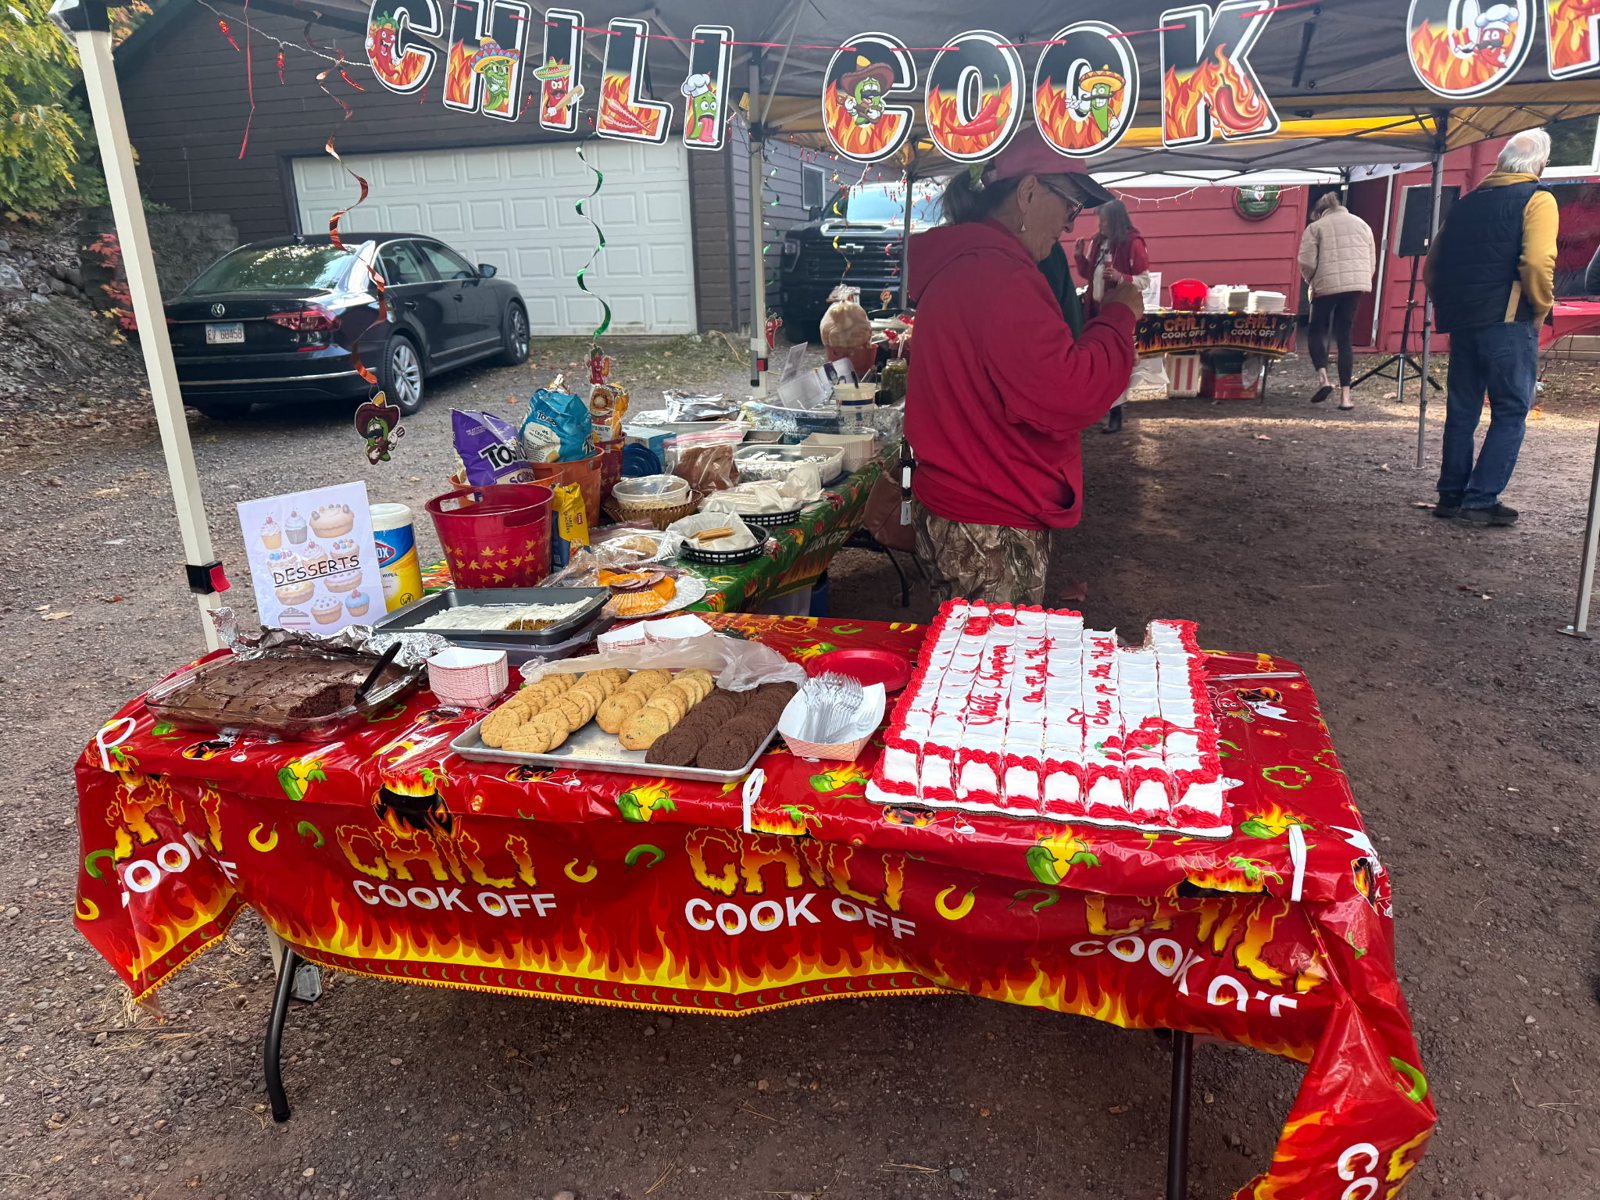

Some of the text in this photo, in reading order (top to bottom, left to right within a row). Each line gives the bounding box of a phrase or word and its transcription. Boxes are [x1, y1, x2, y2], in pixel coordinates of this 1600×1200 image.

[365, 0, 734, 151] CHILI
[823, 0, 1281, 163] COOK
[1161, 330, 1207, 340] COOK OFF
[1163, 316, 1206, 331] CHILI
[1231, 328, 1276, 338] COOK OFF
[1233, 315, 1278, 330] CHILI
[273, 554, 361, 585] DESSERTS
[334, 823, 538, 890] CHILI
[684, 826, 907, 913] CHILI
[352, 879, 559, 919] COOK OFF
[684, 892, 917, 940] COOK OFF
[1069, 935, 1205, 997] COOK
